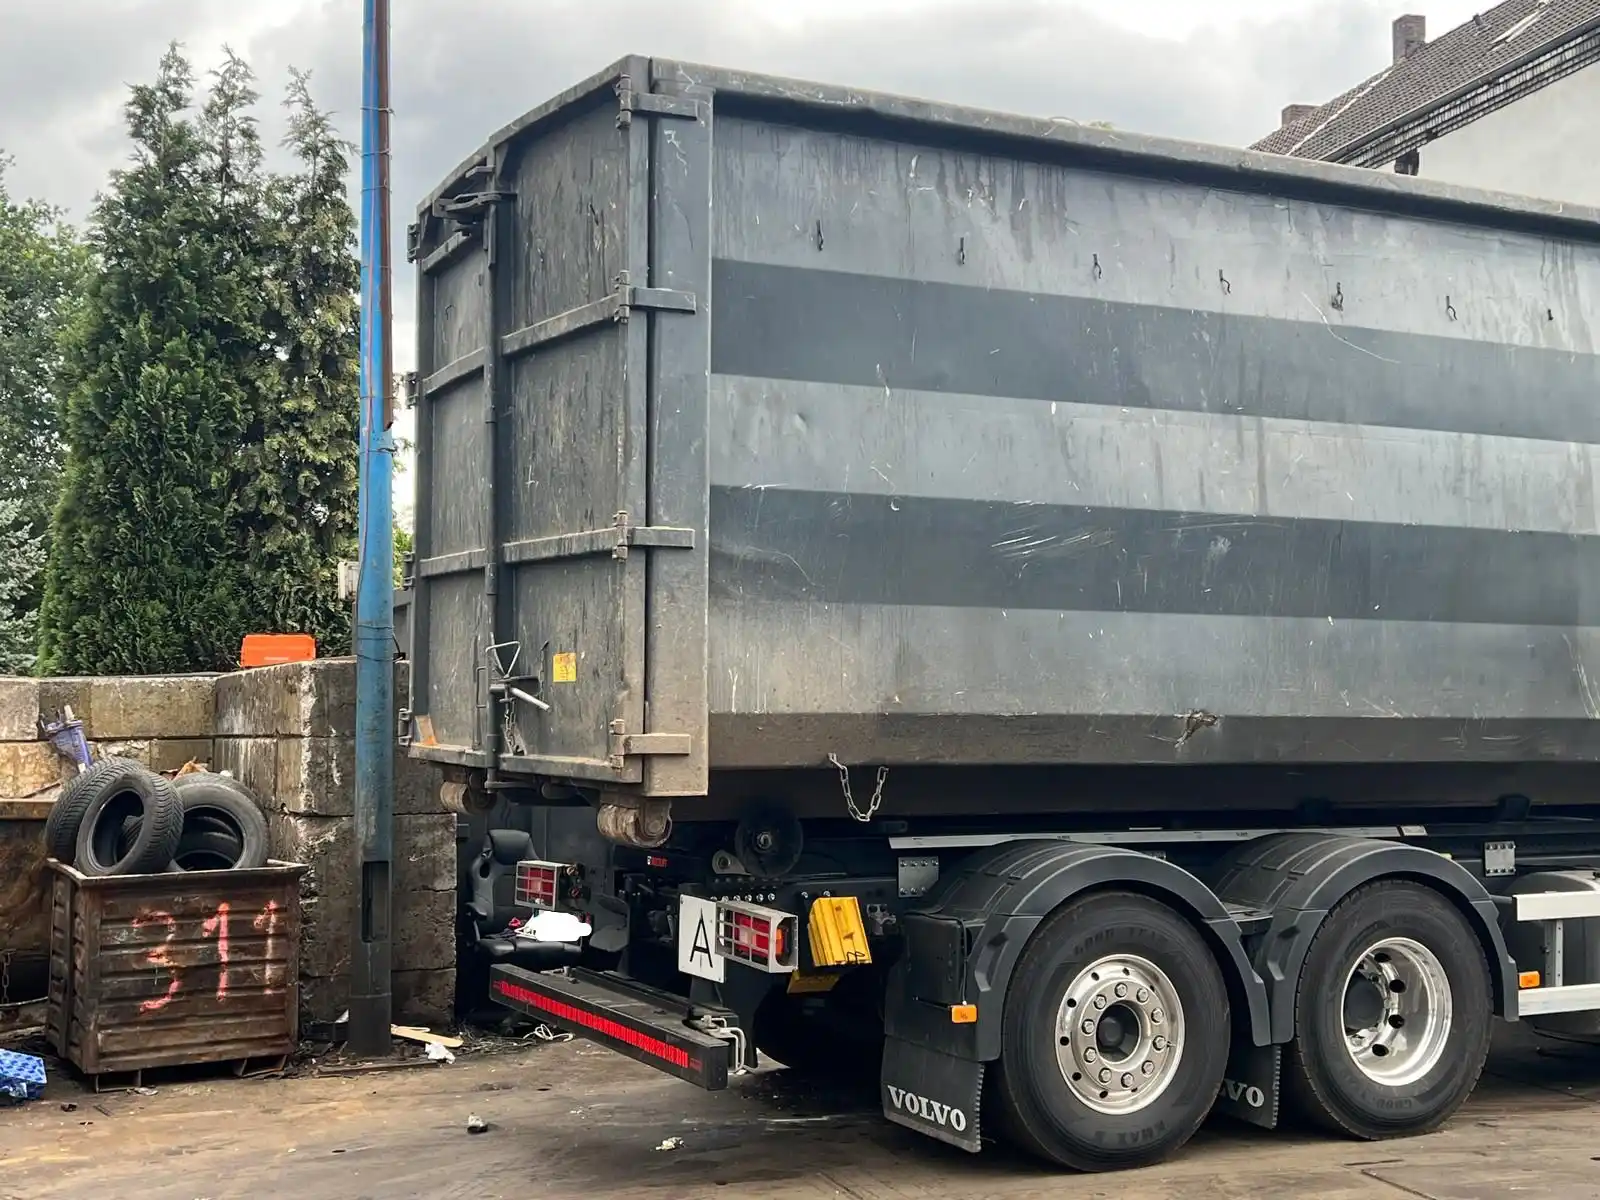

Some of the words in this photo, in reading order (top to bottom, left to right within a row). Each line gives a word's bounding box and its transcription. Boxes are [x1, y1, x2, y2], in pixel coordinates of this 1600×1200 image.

[131, 900, 279, 1014] 311
[690, 907, 713, 968] A
[887, 1085, 966, 1131] VOLVO
[1221, 1079, 1265, 1108] VO
